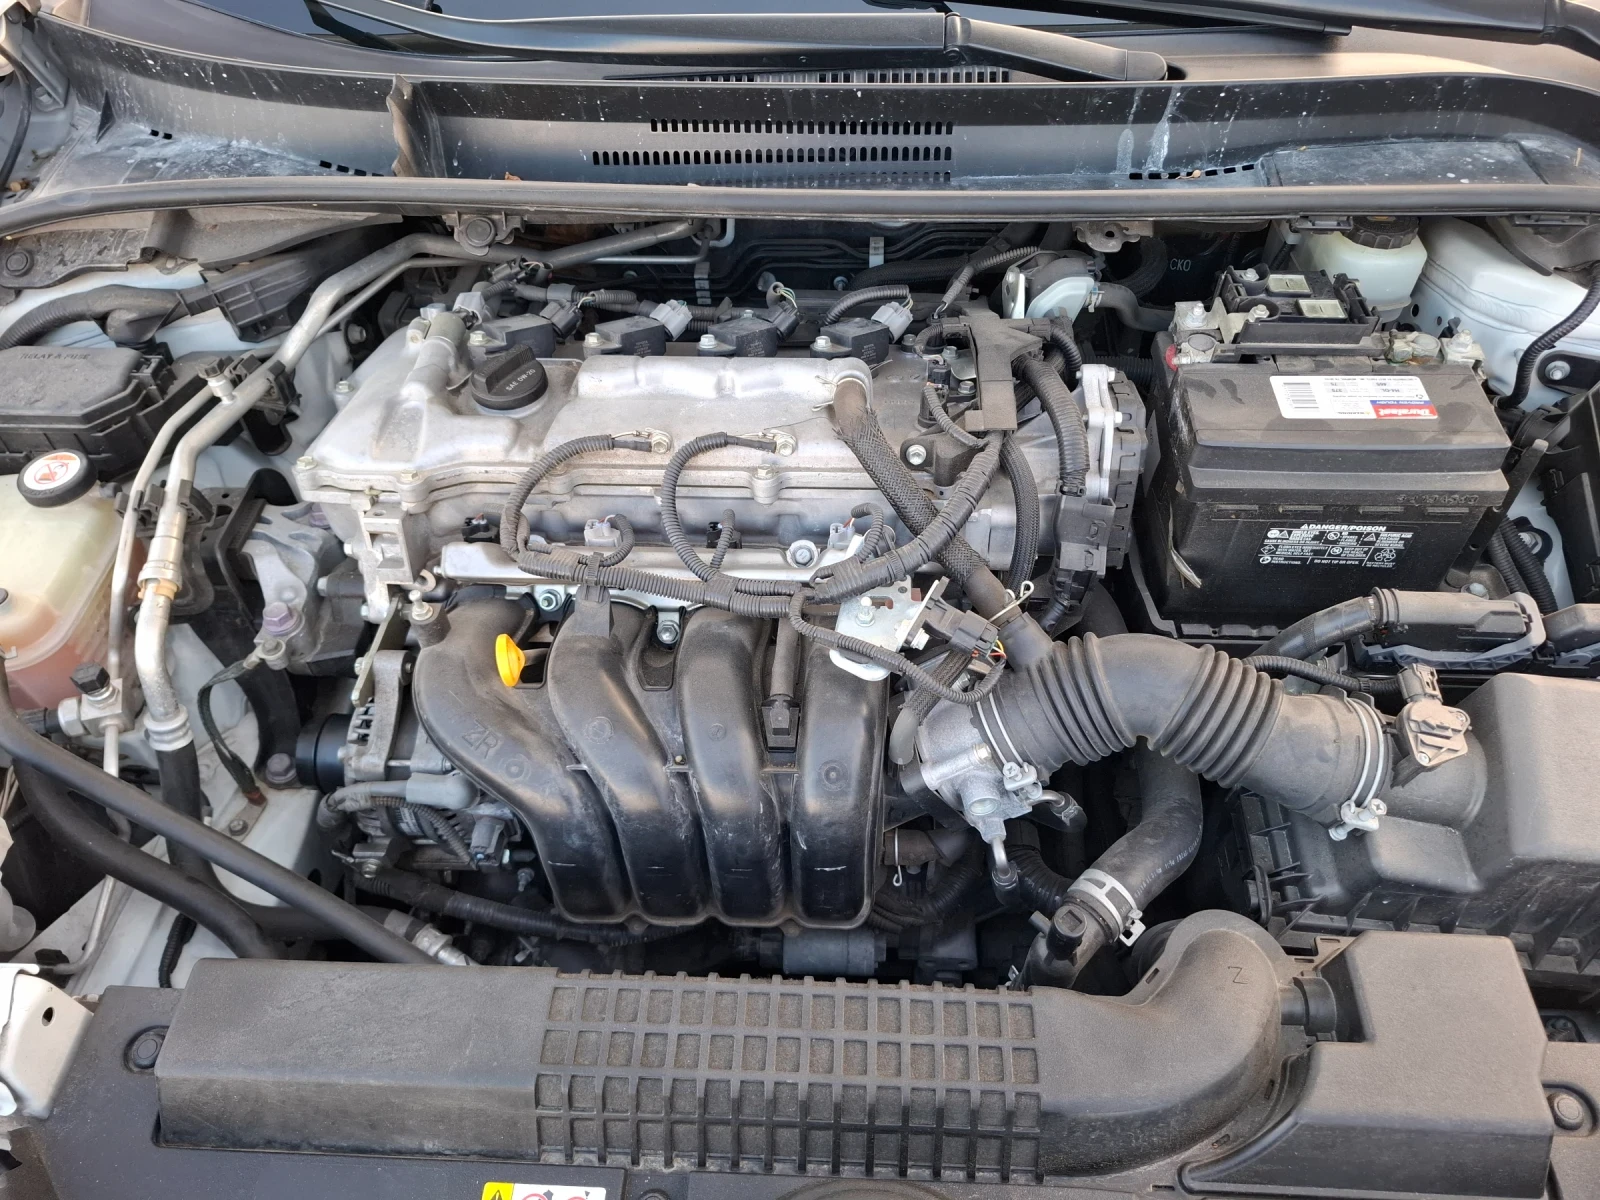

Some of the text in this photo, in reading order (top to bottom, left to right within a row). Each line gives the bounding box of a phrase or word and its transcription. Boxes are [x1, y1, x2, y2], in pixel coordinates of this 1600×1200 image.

[505, 381, 519, 391] SAE
[1378, 408, 1434, 416] Duralast
[1308, 524, 1387, 532] DANGER/POISON
[461, 719, 498, 760] ZR
